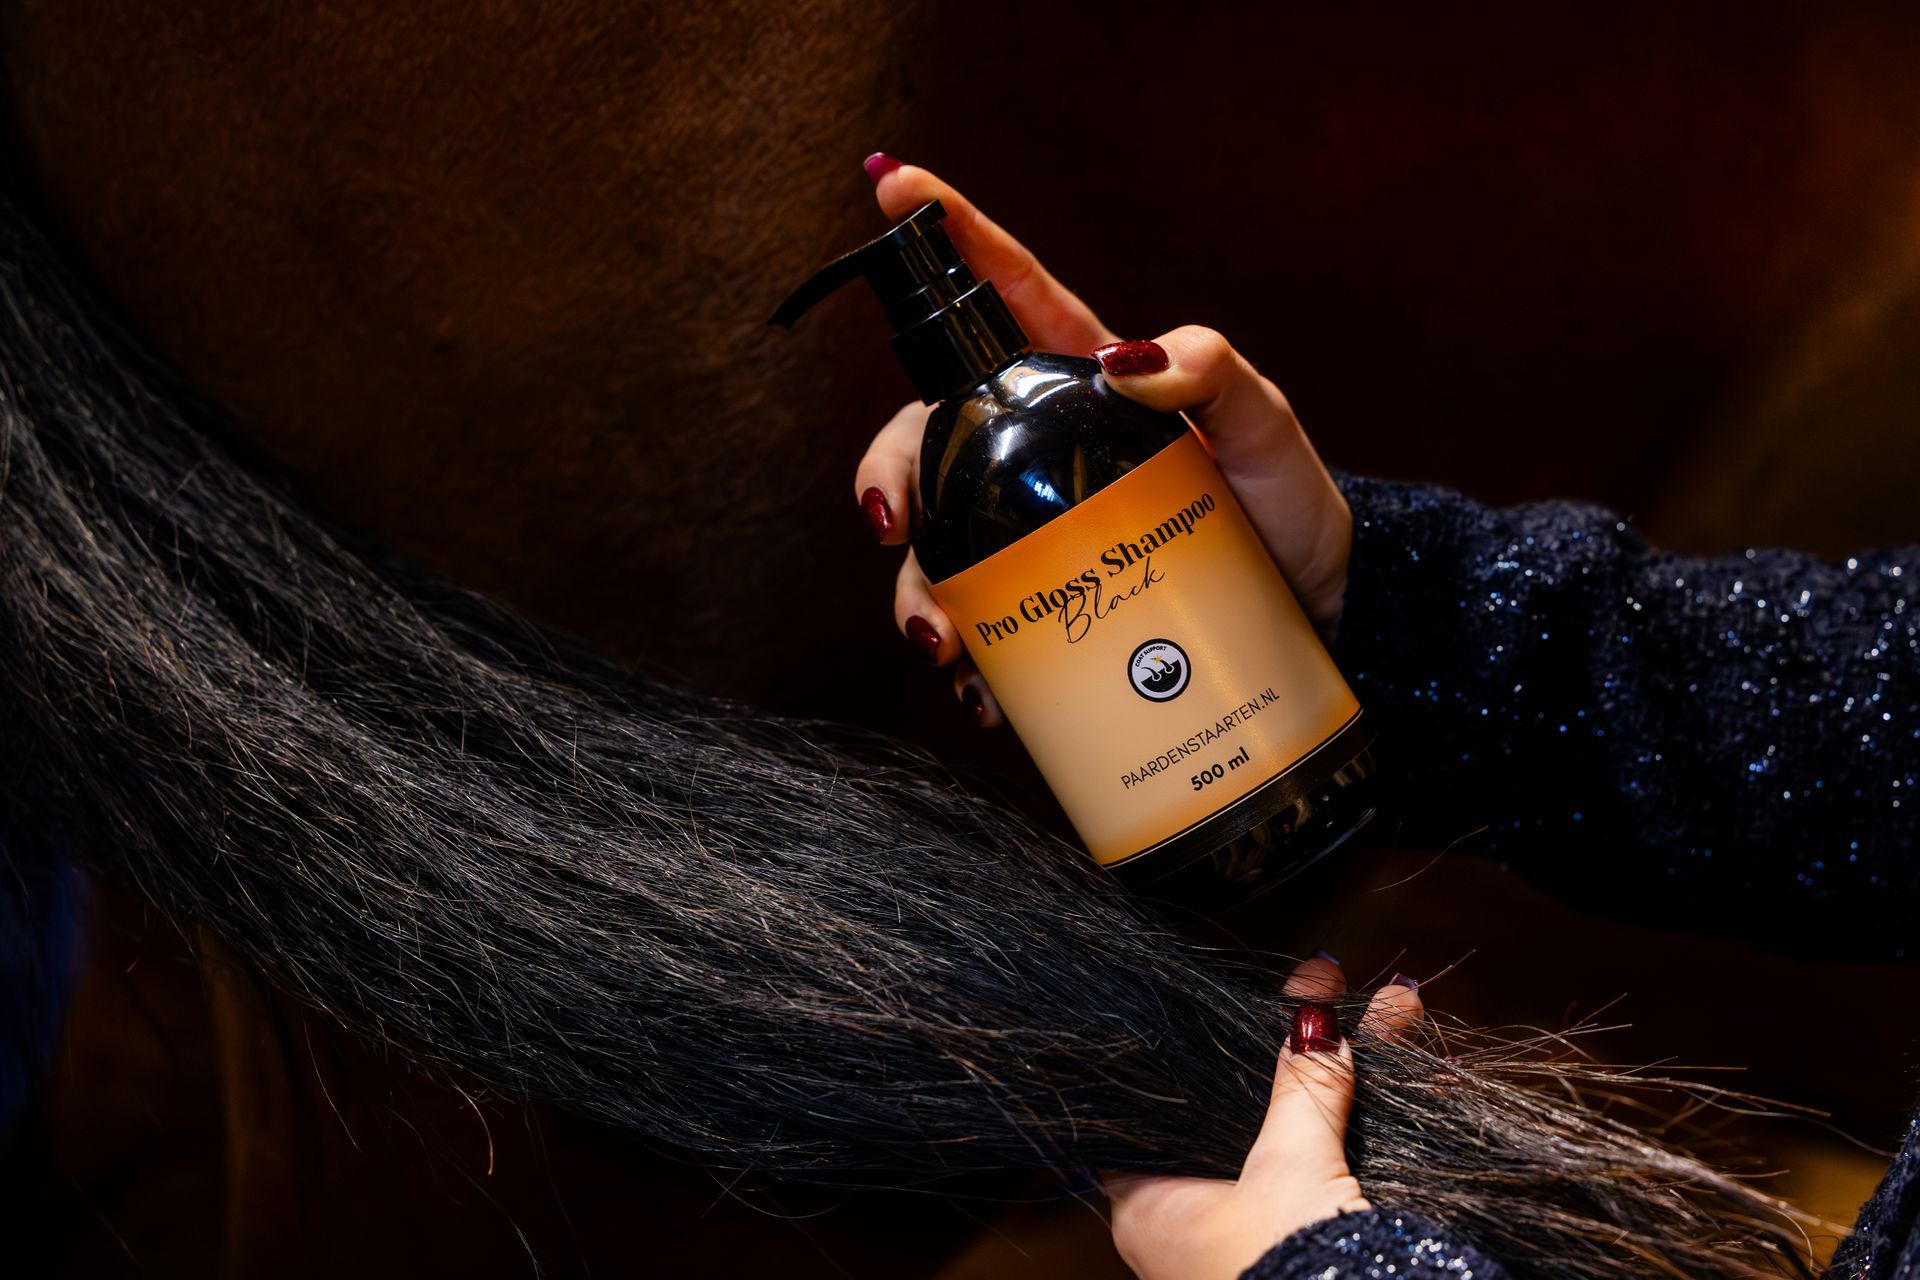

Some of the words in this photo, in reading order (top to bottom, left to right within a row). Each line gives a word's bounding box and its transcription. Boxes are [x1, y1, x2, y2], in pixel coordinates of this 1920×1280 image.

[976, 614, 1018, 647] Pro
[1019, 567, 1101, 624] Gloss
[1100, 492, 1216, 575] Shampoo
[1057, 557, 1165, 644] Black
[1135, 654, 1145, 667] COAT
[1144, 645, 1167, 655] SUPPORT
[1121, 687, 1280, 790] PAARDENSTAARTEN.NL
[1190, 763, 1226, 792] 500
[1227, 747, 1251, 775] ml
